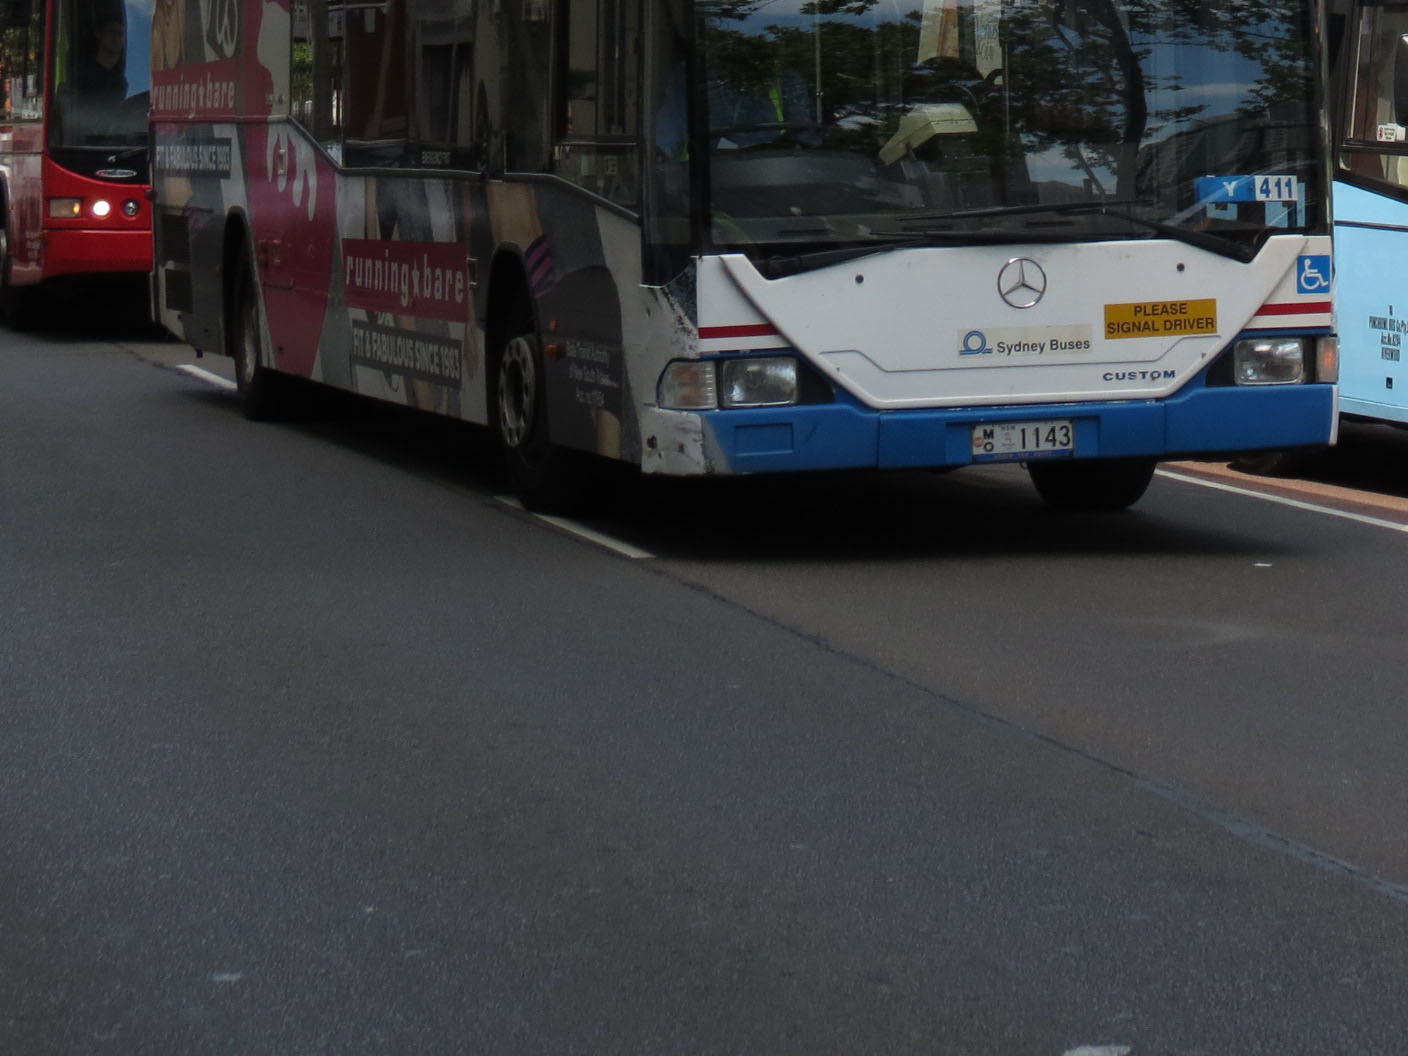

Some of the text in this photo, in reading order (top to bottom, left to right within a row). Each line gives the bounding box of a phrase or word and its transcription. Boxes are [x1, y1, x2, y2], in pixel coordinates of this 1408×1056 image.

[152, 71, 236, 119] running bare
[1222, 177, 1293, 199] Y 411
[345, 248, 465, 308] running bare
[1133, 302, 1188, 317] PLEASE
[1106, 317, 1215, 335] SIGNAL DRIVER
[353, 327, 460, 380] FIT & FABULOUS SINCE 1983
[996, 338, 1091, 356] Sydney Buses
[1102, 369, 1176, 382] CUSTOM
[1020, 425, 1071, 450] 1143
